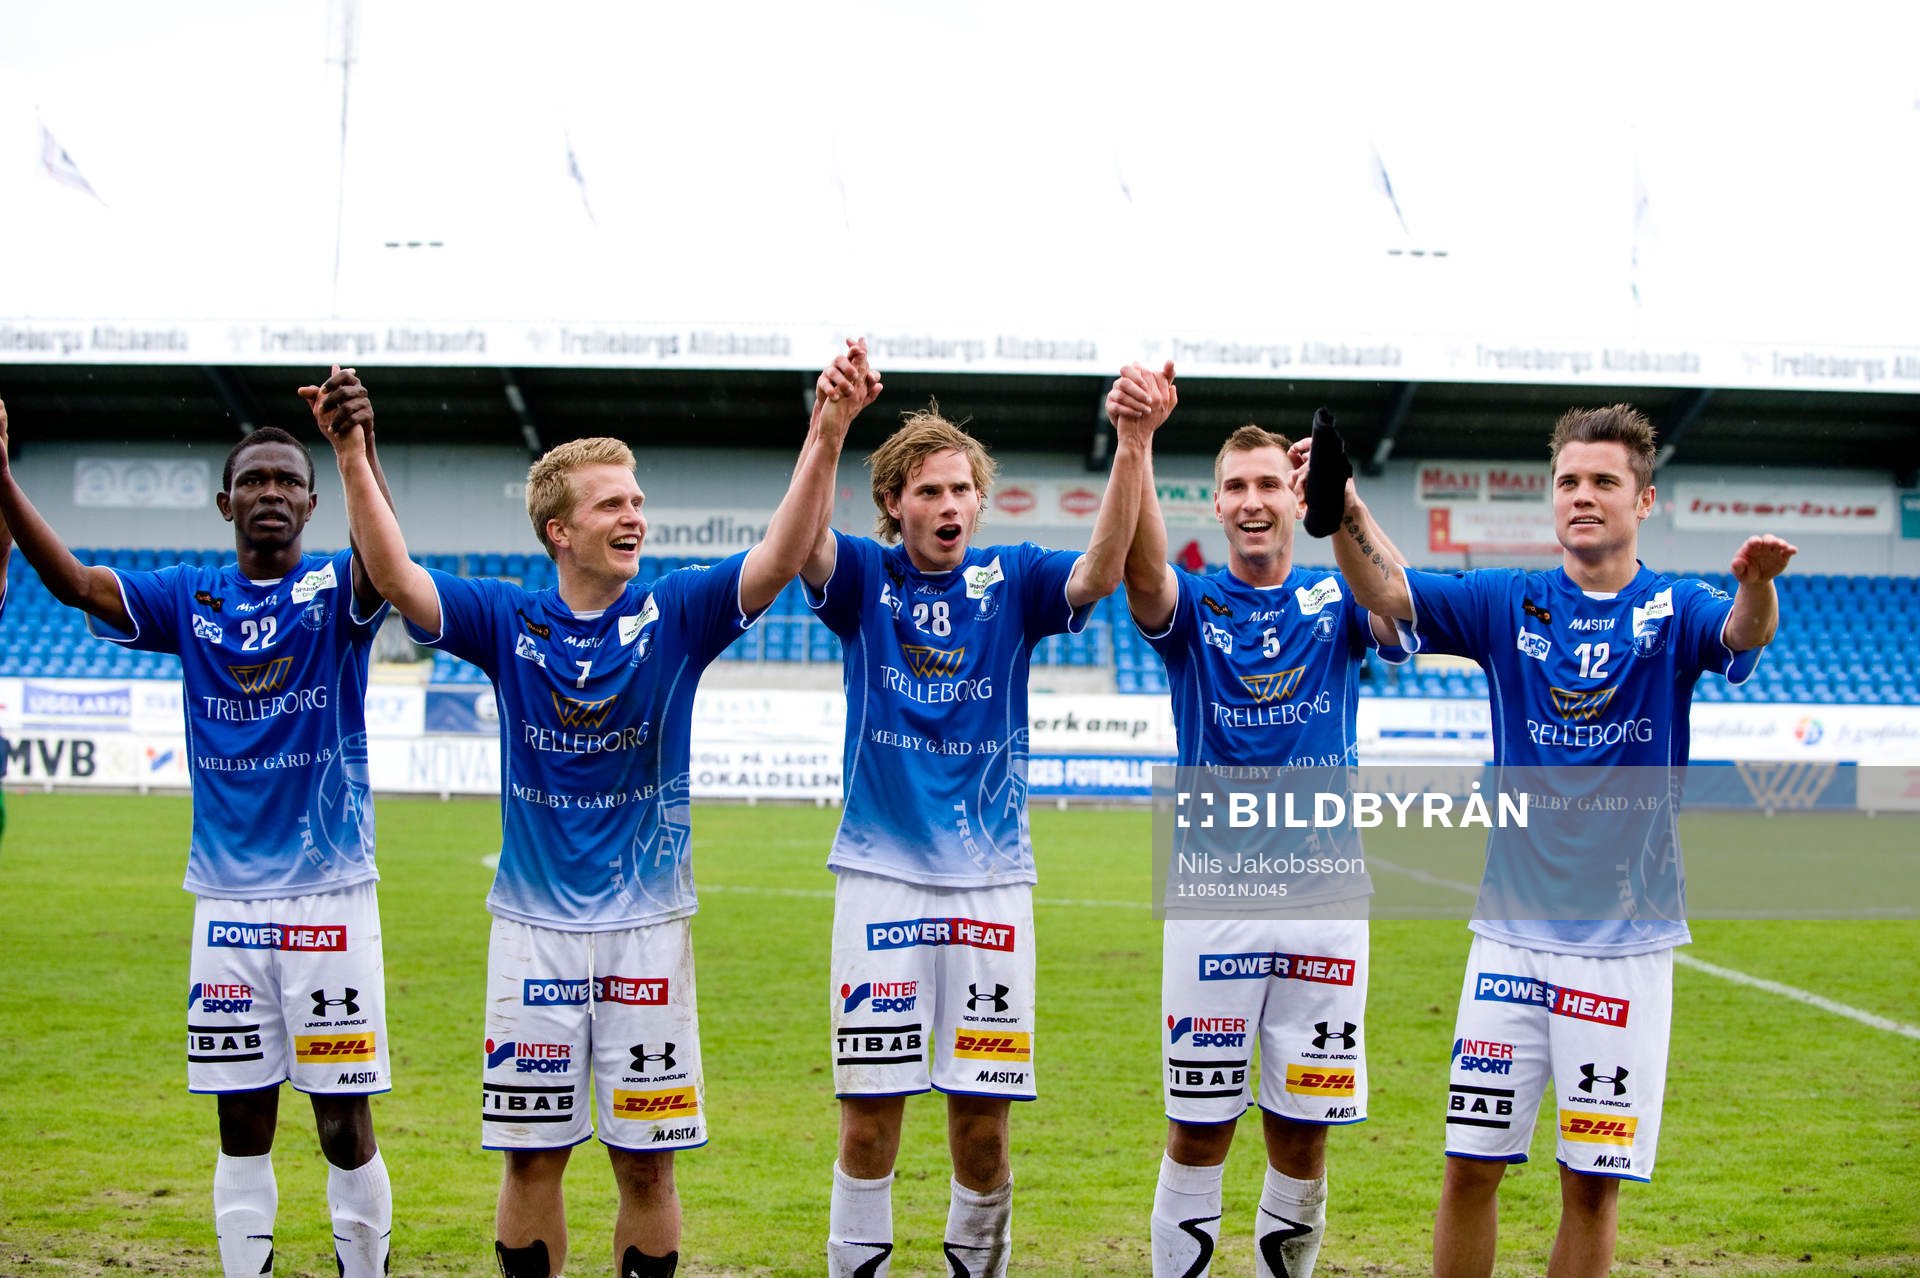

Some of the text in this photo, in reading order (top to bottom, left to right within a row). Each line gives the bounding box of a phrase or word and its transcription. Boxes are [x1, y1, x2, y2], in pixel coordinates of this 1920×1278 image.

[912, 601, 952, 637] 28
[1568, 618, 1616, 631] MASITA
[241, 616, 278, 651] 22
[1263, 627, 1281, 659] 5
[1573, 642, 1611, 679] 12
[575, 660, 593, 689] 7
[880, 665, 993, 704] TRELLEBORG
[203, 686, 327, 722] TRELLEBORG
[1028, 711, 1148, 739] erkamp
[1527, 718, 1653, 747] RELLEBORG
[977, 740, 999, 755] AB
[198, 748, 332, 772] MELLBY GÅRD AB
[1320, 753, 1339, 768] AB
[690, 771, 840, 788] OKALDELEN
[577, 791, 627, 809] GÅRD
[631, 785, 654, 802] AB
[1578, 793, 1628, 811] GÅRD
[1634, 797, 1657, 811] AB
[212, 926, 341, 947] POWER HEAT
[873, 923, 1010, 946] POWER HEAT
[1204, 957, 1352, 981] POWER HEAT
[203, 984, 252, 999] INTER
[529, 981, 663, 1001] POWER HEAT
[872, 981, 917, 997] INTER
[203, 1000, 253, 1014] SPORT
[872, 996, 916, 1014] SPORT
[1479, 978, 1623, 1022] POWER HEAT
[980, 1016, 1017, 1024] ARMOUR
[1194, 1018, 1245, 1032] INTER
[188, 1034, 262, 1050] IBAB
[307, 1039, 370, 1056] DHL
[837, 1035, 922, 1053] TIBAB
[954, 1036, 1017, 1054] DHL
[1192, 1033, 1246, 1048] SPORT
[1462, 1039, 1513, 1060] INTER
[517, 1043, 570, 1058] INTER
[1301, 1052, 1328, 1060] UNDER
[516, 1059, 571, 1074] SPORT
[1460, 1056, 1513, 1076] SPORT
[337, 1072, 377, 1086] MASITA
[652, 1073, 687, 1083] ARMOUR
[976, 1071, 1024, 1085] MASITA
[1169, 1068, 1246, 1086] IBAB
[624, 1095, 689, 1113] DHL
[1450, 1095, 1513, 1116] BAB
[1568, 1096, 1632, 1108] UNDER ARMOUR
[652, 1126, 697, 1143] MASITA
[1569, 1119, 1627, 1138] DHL
[1593, 1155, 1631, 1170] MASITA
